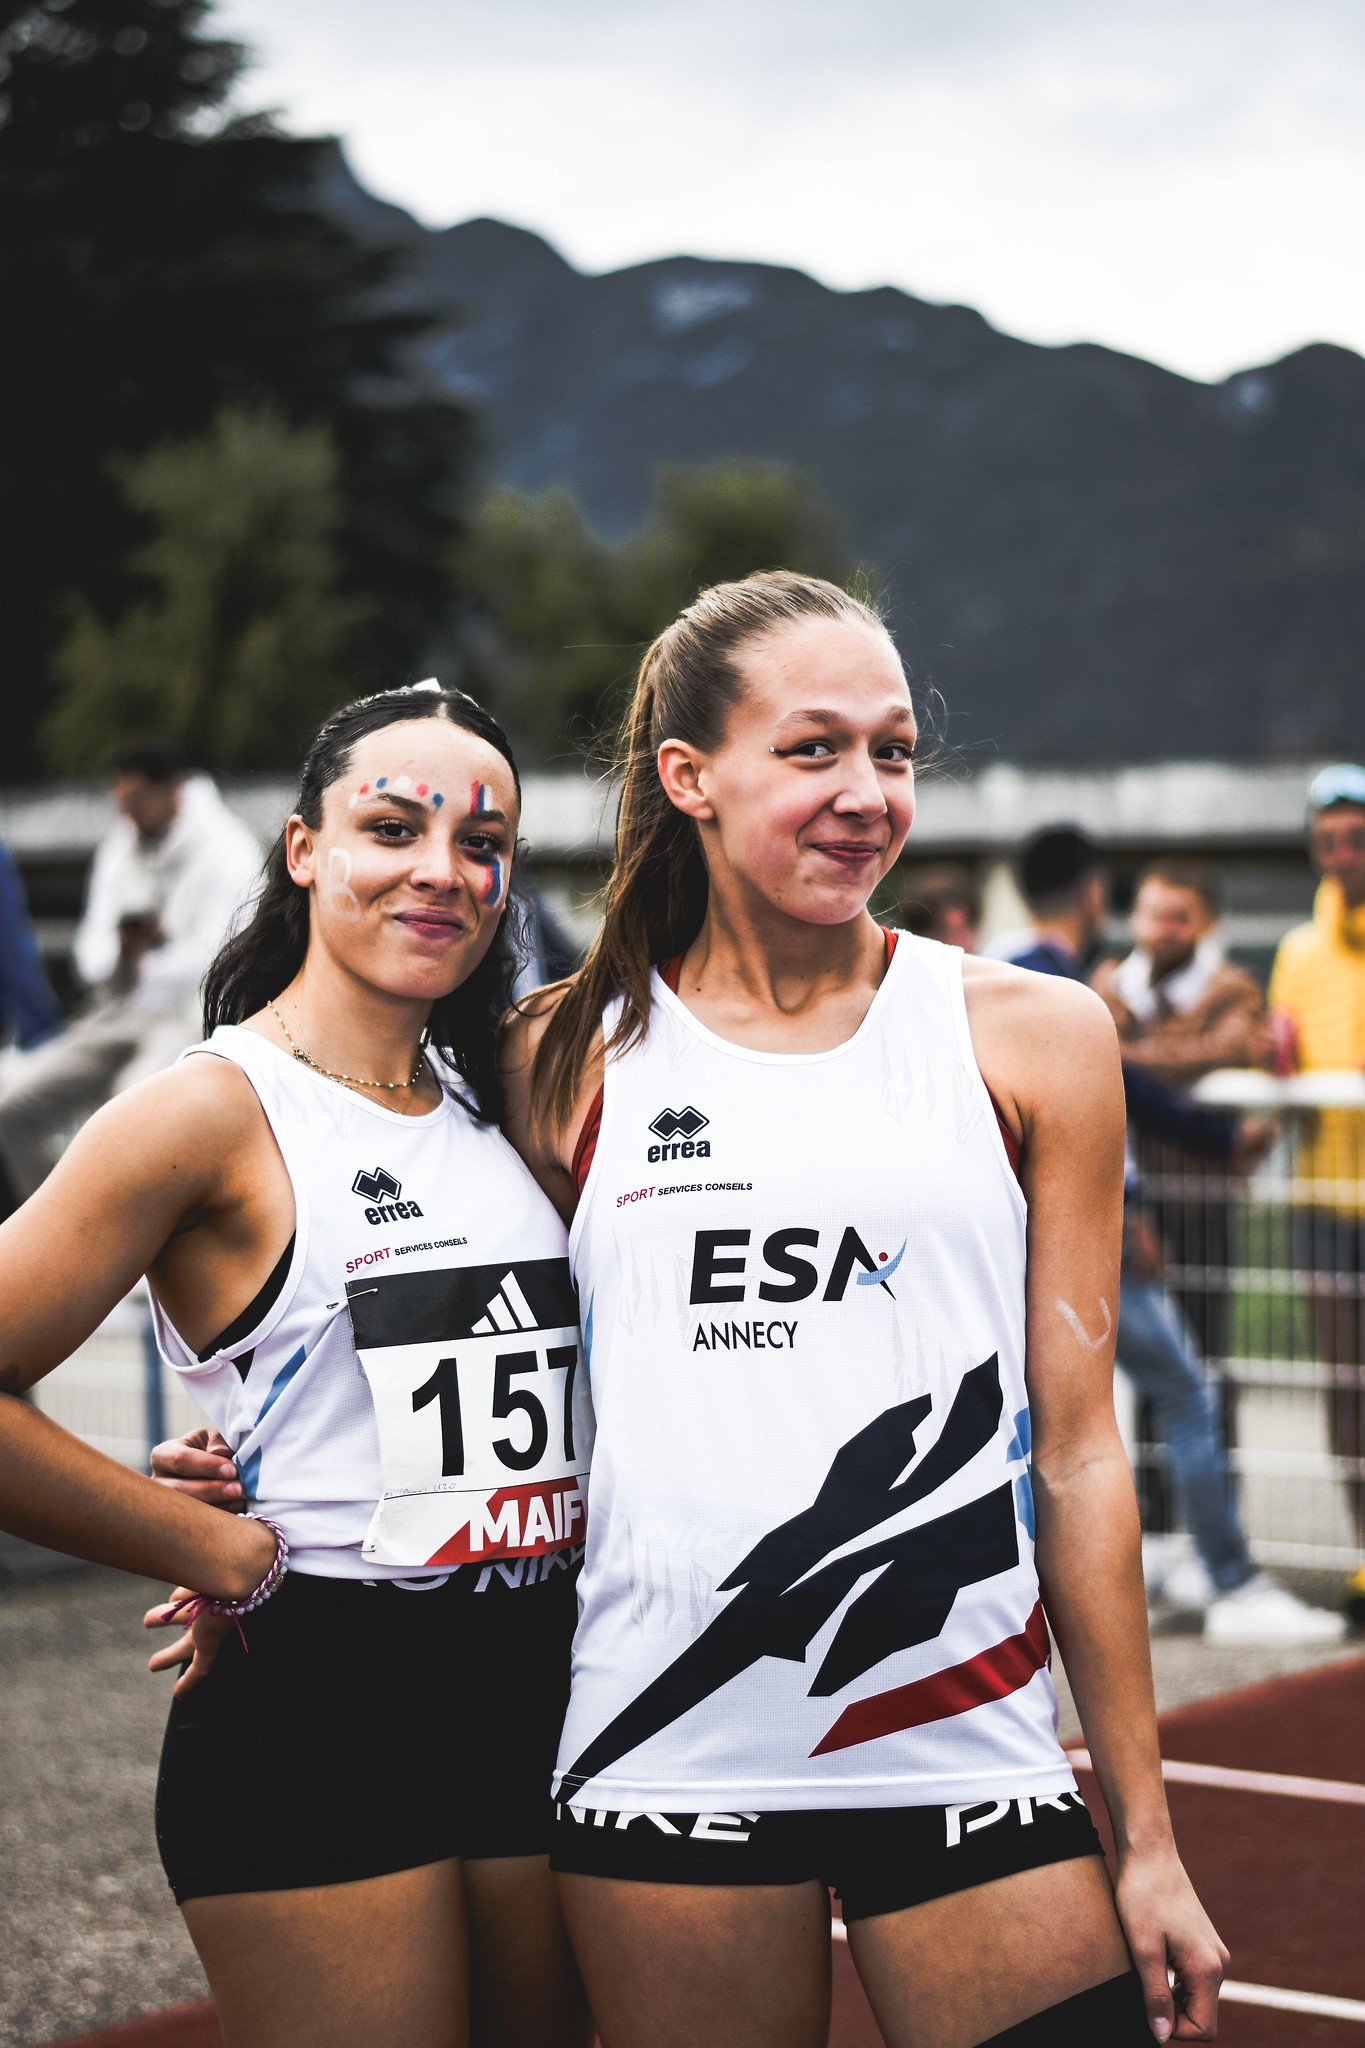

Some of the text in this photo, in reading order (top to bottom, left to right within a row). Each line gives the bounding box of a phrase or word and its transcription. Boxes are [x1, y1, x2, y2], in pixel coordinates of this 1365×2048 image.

[647, 1140, 711, 1163] errea
[364, 1201, 424, 1225] errea
[616, 1182, 753, 1208] SPORT SERVICES CONSEILS
[345, 1236, 468, 1273] SPORT SERVICES CONSEILS
[689, 1226, 898, 1305] ESA
[693, 1321, 798, 1351] ANNECY
[412, 1345, 578, 1477] 157
[469, 1491, 582, 1552] MAIF
[945, 1791, 1086, 1848] PR
